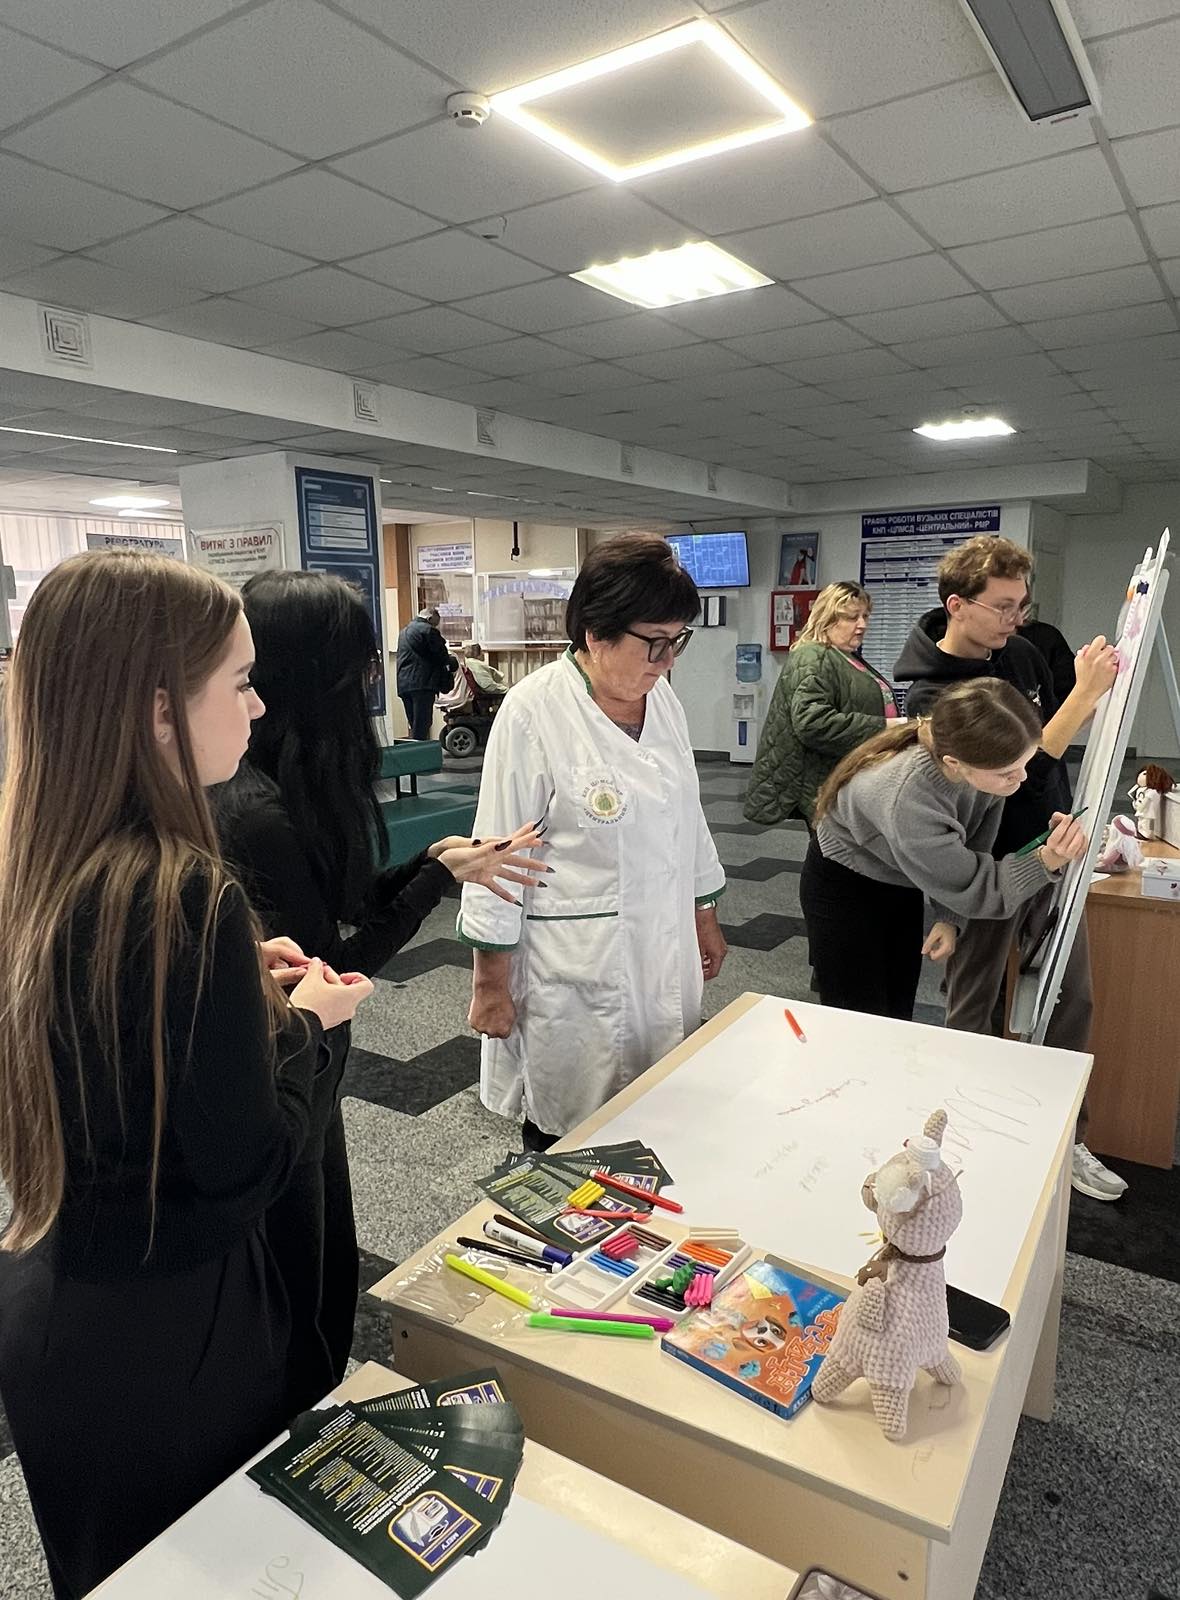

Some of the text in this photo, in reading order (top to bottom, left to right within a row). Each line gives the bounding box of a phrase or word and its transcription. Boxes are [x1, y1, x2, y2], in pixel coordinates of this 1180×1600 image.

[888, 515, 916, 524] РОБОТИ
[916, 512, 949, 522] ВУЗЬКИХ
[949, 509, 999, 520] СПЕЦІАЛІСТІВ
[200, 535, 273, 551] ВИТЯГ З ПРАВИЛ
